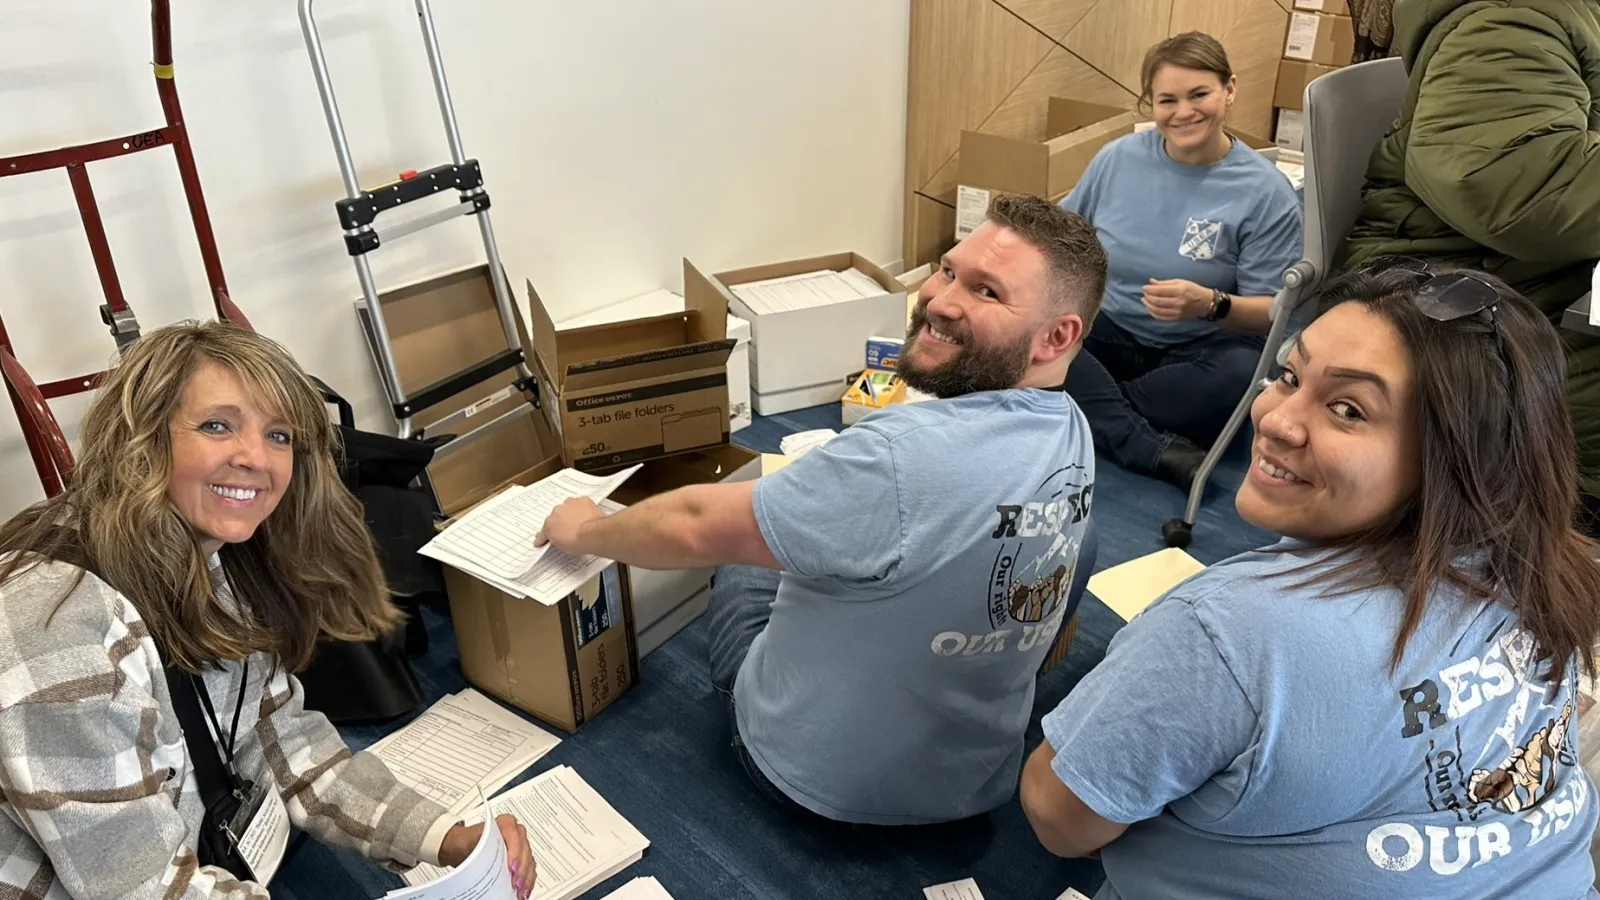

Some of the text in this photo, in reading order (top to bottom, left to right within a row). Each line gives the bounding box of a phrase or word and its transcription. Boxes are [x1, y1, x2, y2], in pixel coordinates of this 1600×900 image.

[132, 130, 166, 149] UEA
[575, 392, 633, 407] Office DEPOT
[578, 402, 675, 428] 3-tab file folders
[992, 483, 1094, 539] RESPEC
[996, 555, 1012, 587] Our
[597, 643, 610, 701] file folders
[616, 664, 626, 687] 250
[1399, 629, 1538, 739] RESP
[589, 676, 601, 709] 3-tab
[1435, 750, 1456, 794] Our
[1366, 821, 1512, 875] OUR
